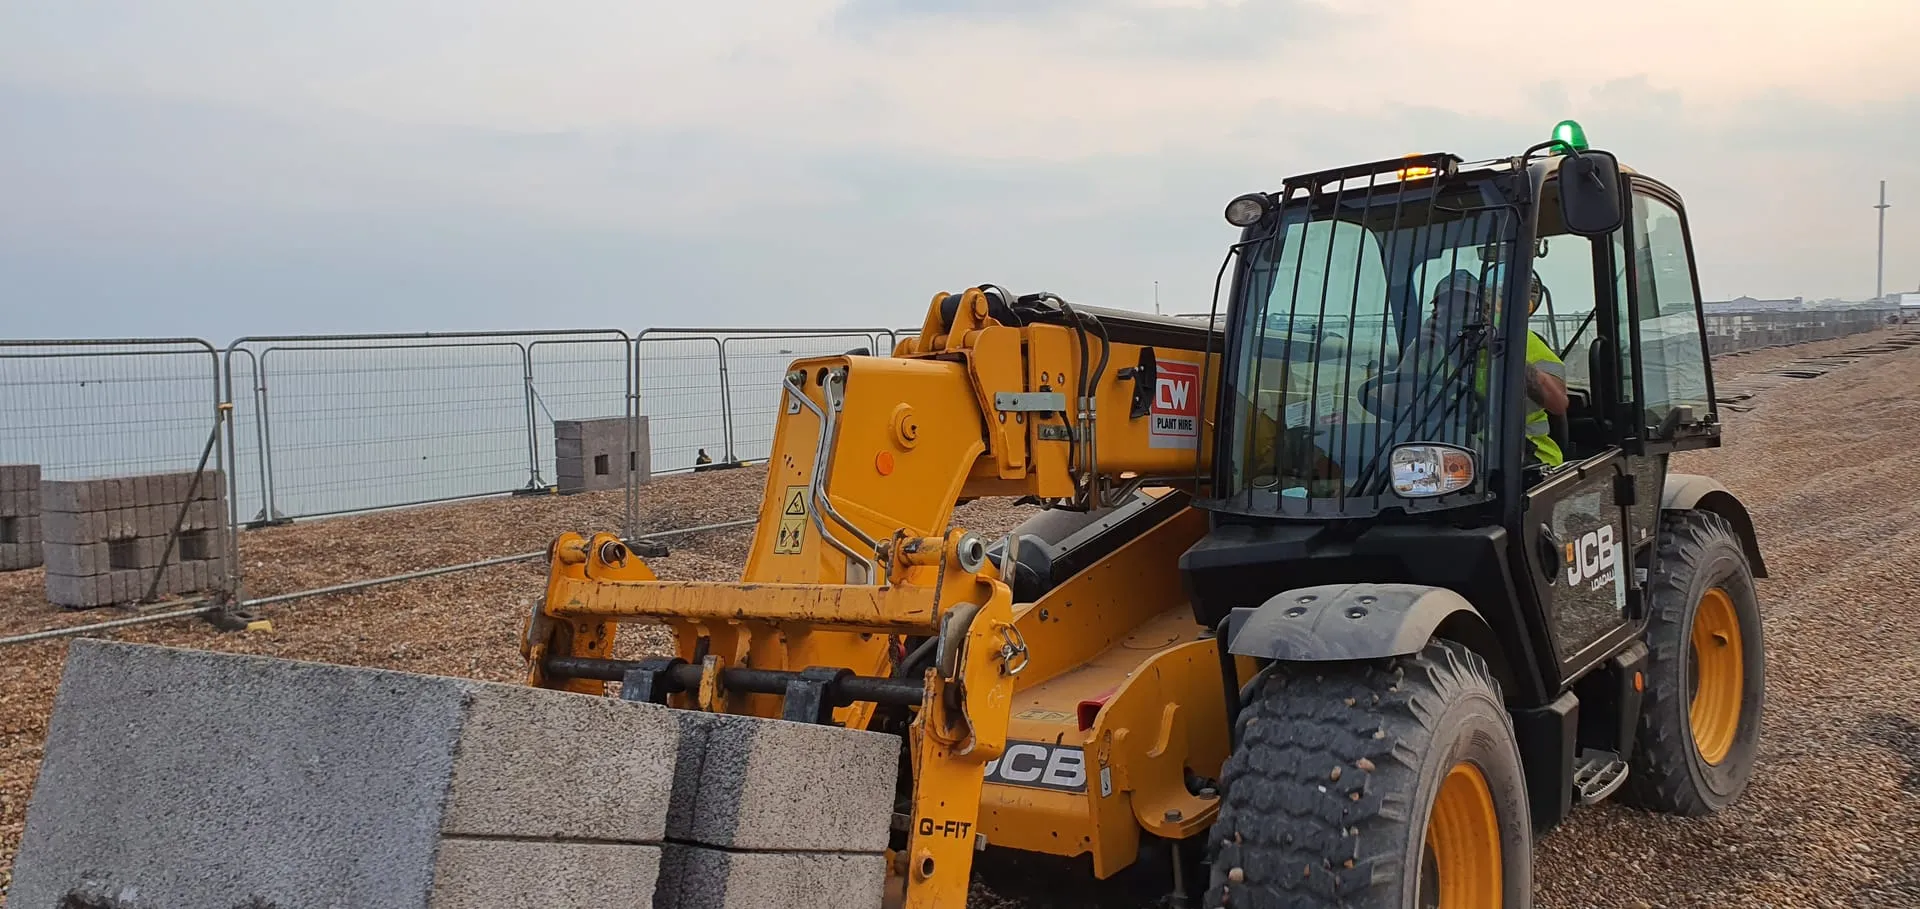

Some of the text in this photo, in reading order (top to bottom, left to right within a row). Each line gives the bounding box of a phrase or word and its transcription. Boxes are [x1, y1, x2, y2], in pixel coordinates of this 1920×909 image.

[1155, 378, 1190, 410] CW
[1157, 417, 1193, 431] PLANT HIRE
[1567, 524, 1615, 587] JCB
[919, 817, 972, 839] Q-FIT
